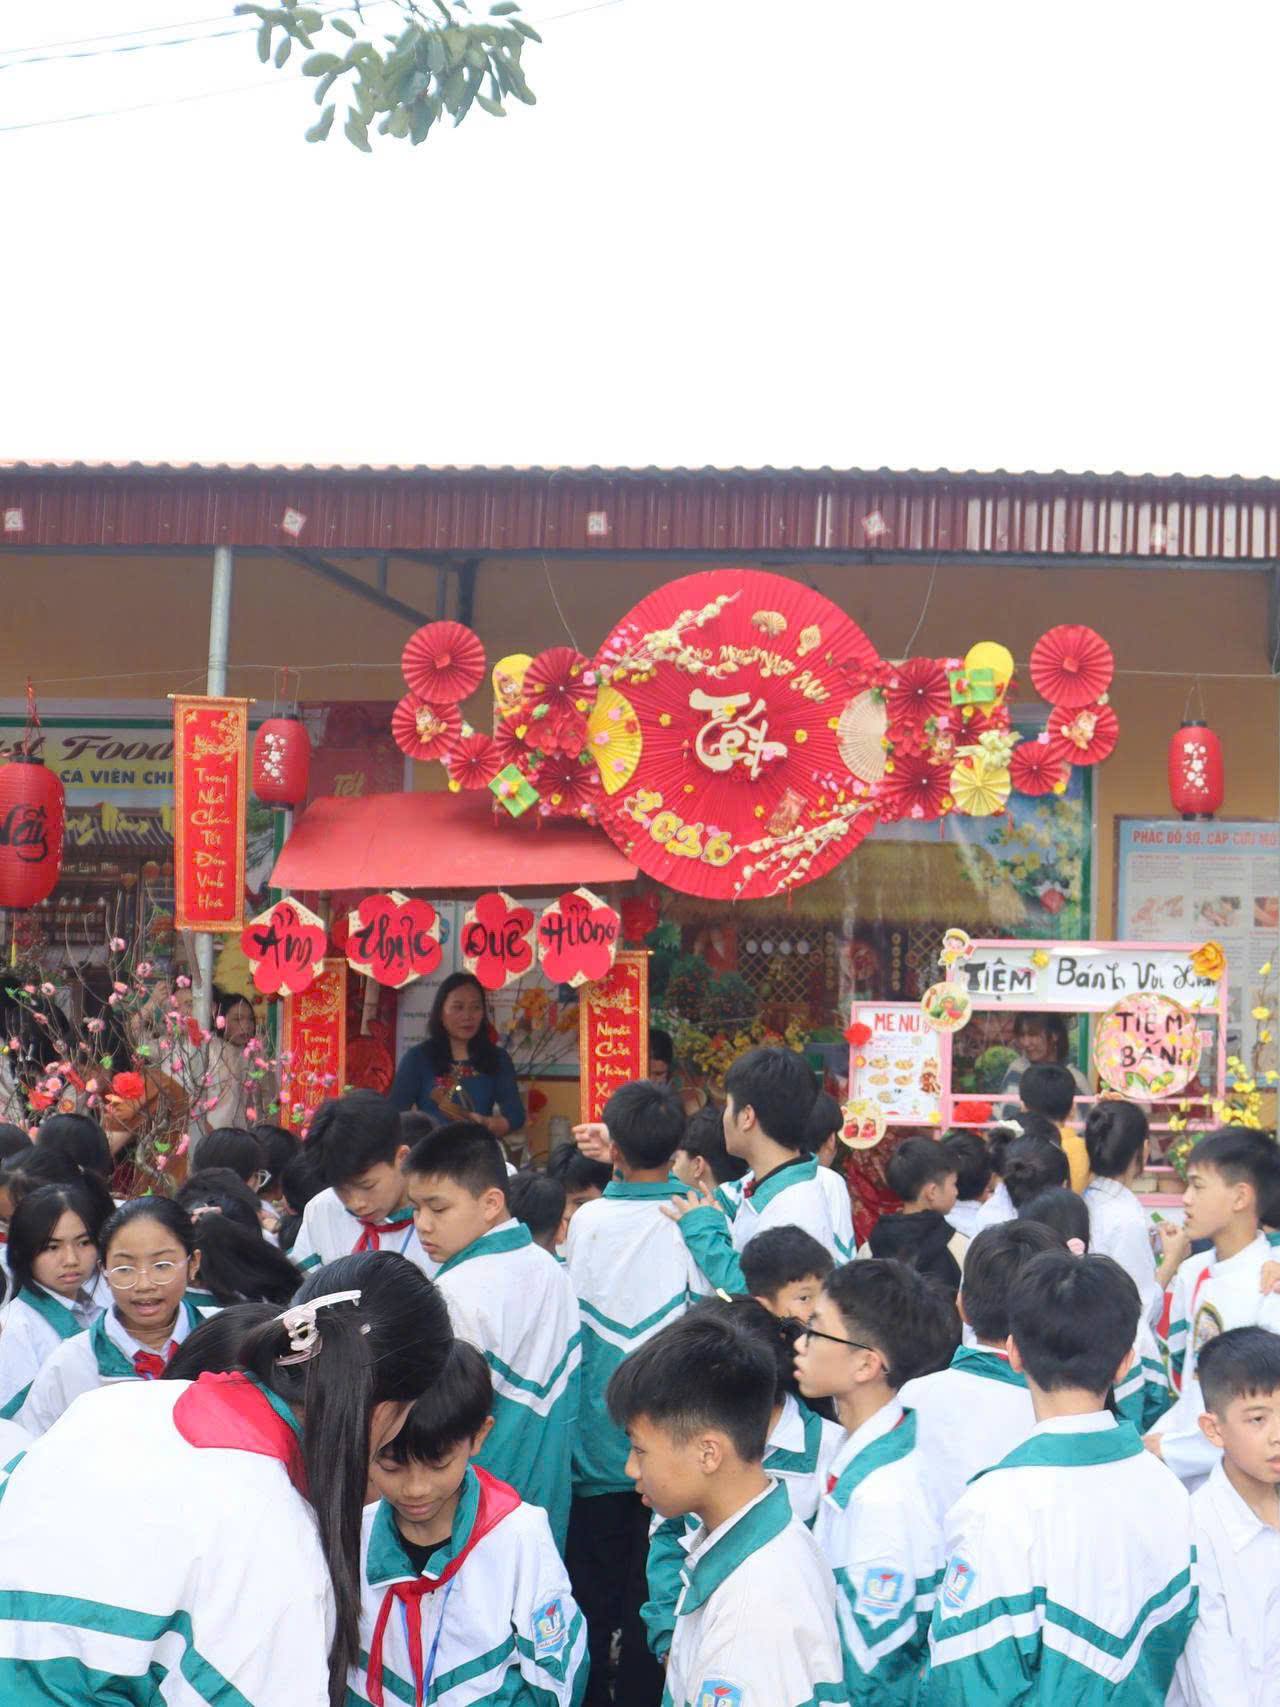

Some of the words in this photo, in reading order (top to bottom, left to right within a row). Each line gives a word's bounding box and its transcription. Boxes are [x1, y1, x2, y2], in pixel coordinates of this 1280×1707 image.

[689, 687, 788, 780] Tết
[623, 789, 733, 867] 2026
[1056, 956, 1126, 990] Bánh
[873, 1012, 920, 1034] MENU
